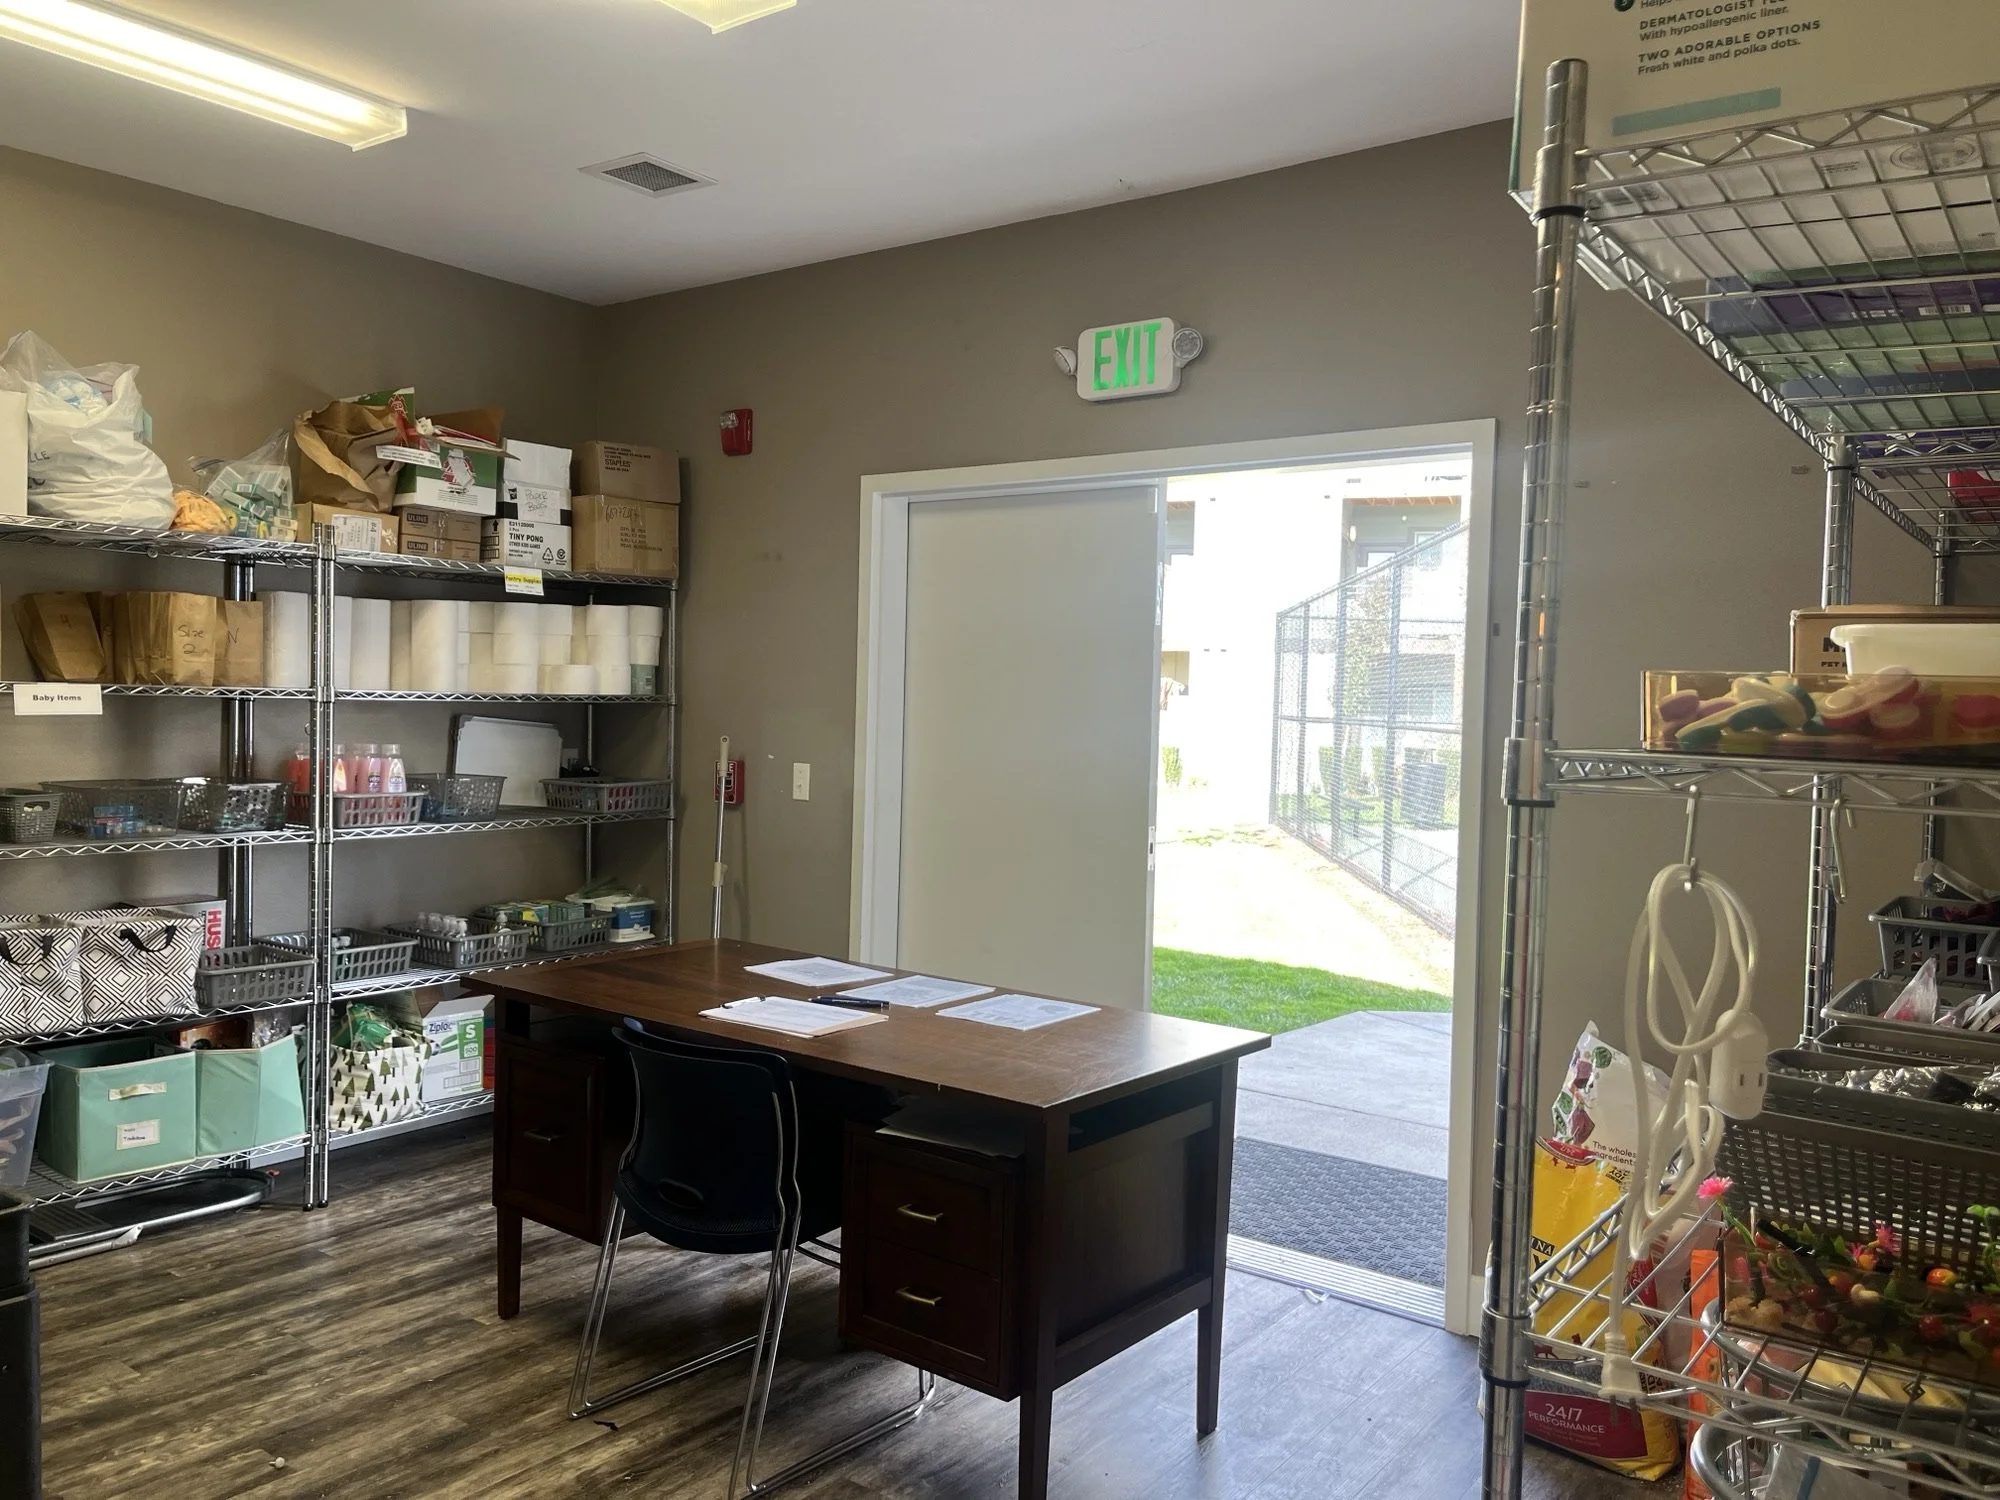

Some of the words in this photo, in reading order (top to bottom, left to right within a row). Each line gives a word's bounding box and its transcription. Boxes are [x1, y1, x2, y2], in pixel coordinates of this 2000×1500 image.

[1639, 28, 1667, 41] With
[1670, 12, 1757, 36] hypoallergenic
[1760, 6, 1789, 17] liner.
[1640, 0, 1754, 29] DERMATOLOGIST
[1638, 49, 1670, 63] TWO
[1674, 33, 1751, 56] ADORABLE
[1756, 20, 1821, 40] OPTIONS
[1638, 61, 1670, 75] Fresh
[1673, 54, 1705, 68] white
[1708, 49, 1730, 62] and
[1733, 43, 1767, 58] polka
[1770, 36, 1801, 50] dots.
[1093, 322, 1162, 391] EXIT
[509, 533, 524, 541] TINY
[526, 535, 543, 543] PONG
[32, 694, 54, 702] Baby
[208, 910, 221, 949] HUS
[429, 1021, 453, 1034] Ziploc
[465, 1024, 476, 1039] S
[1593, 1141, 1606, 1150] The
[1528, 1410, 1605, 1433] PERFORMANCE
[1545, 1403, 1583, 1422] 24/7
